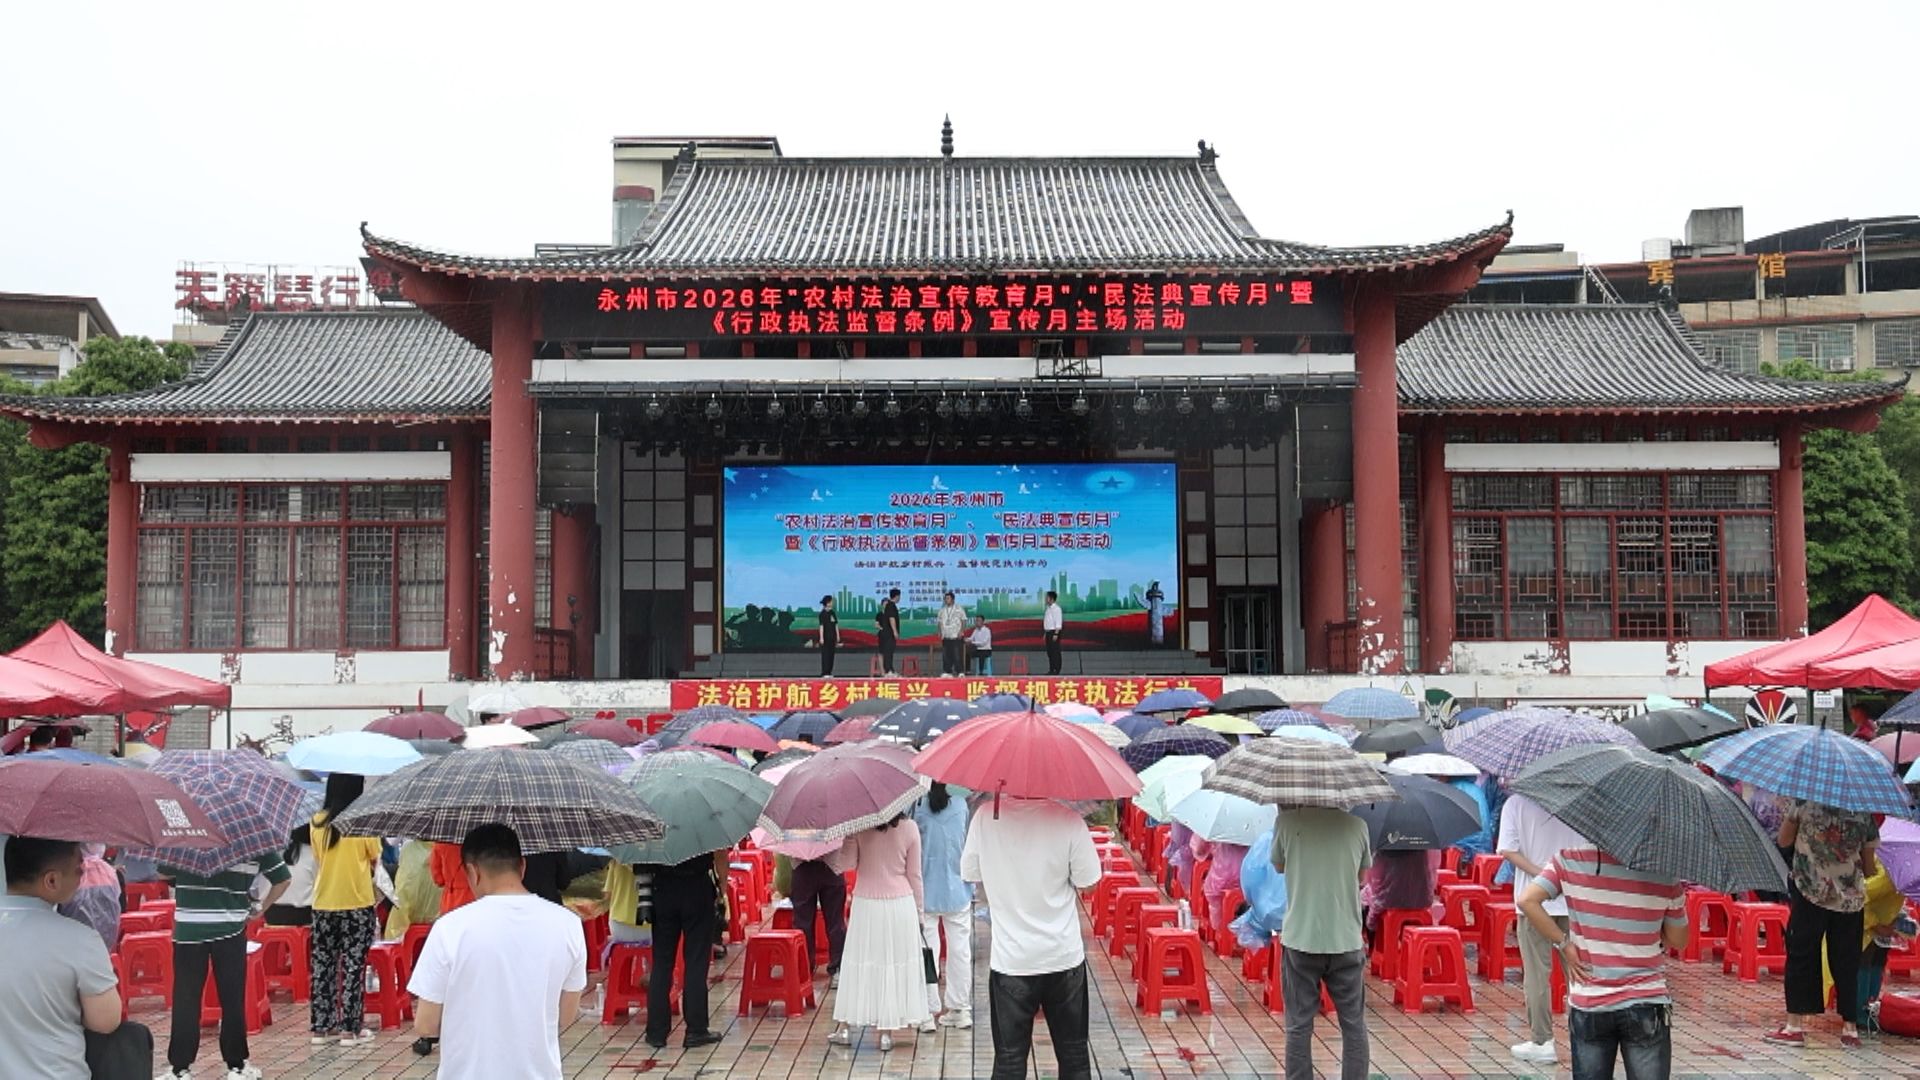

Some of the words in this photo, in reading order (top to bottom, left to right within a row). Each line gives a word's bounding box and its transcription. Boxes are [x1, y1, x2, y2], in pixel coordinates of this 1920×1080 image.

[711, 309, 1185, 334] 《行政执法监督条例》宣传月主场活动
[890, 492, 1004, 507] 2026年永州市
